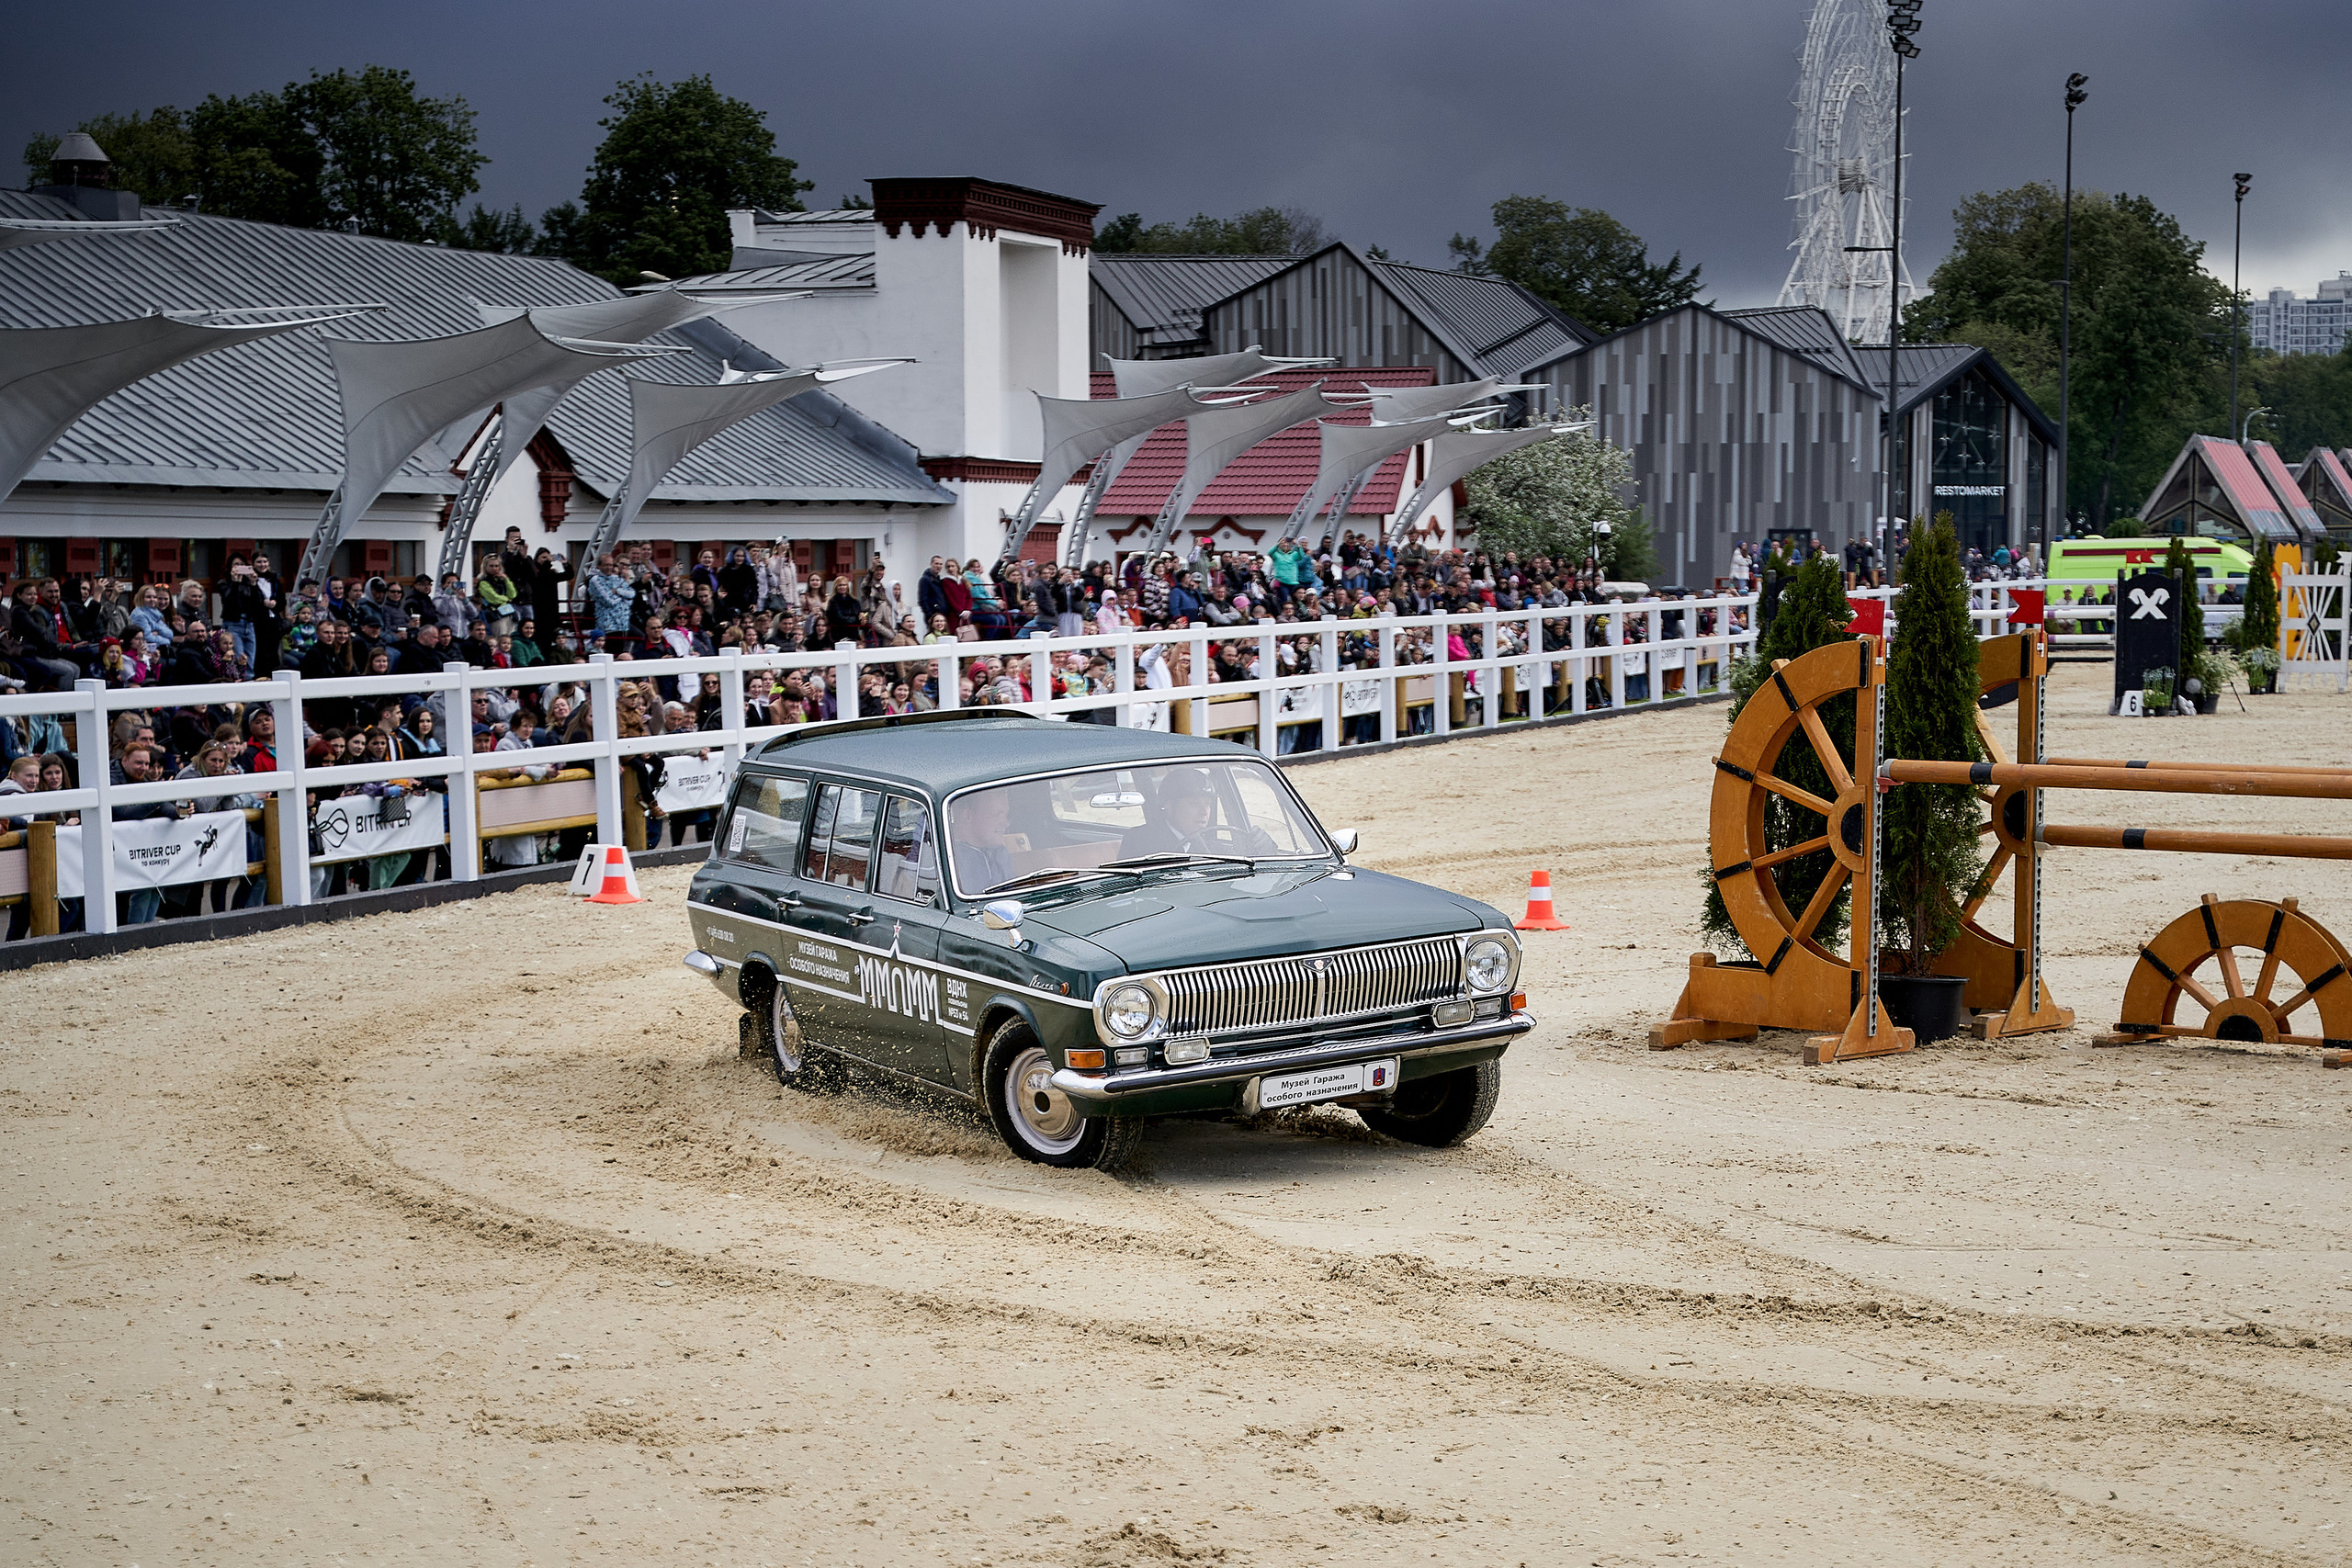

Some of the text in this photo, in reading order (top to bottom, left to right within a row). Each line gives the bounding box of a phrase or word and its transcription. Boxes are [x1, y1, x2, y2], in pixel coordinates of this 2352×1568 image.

[1934, 485, 2006, 497] RESTOMARKET
[2130, 694, 2137, 712] 6
[678, 773, 711, 787] BITRIVER CUP
[129, 844, 182, 860] BITRIVER CUP
[582, 853, 595, 886] 7
[798, 941, 838, 963] МУЗЕЙ ГАРАЖА
[790, 956, 851, 985] ОСОБОГО НАЗНАЧЕНИЯ
[946, 977, 967, 998] ВДНХ
[1281, 1073, 1345, 1089] Музей Гаража
[1266, 1082, 1359, 1102] особого назначения
